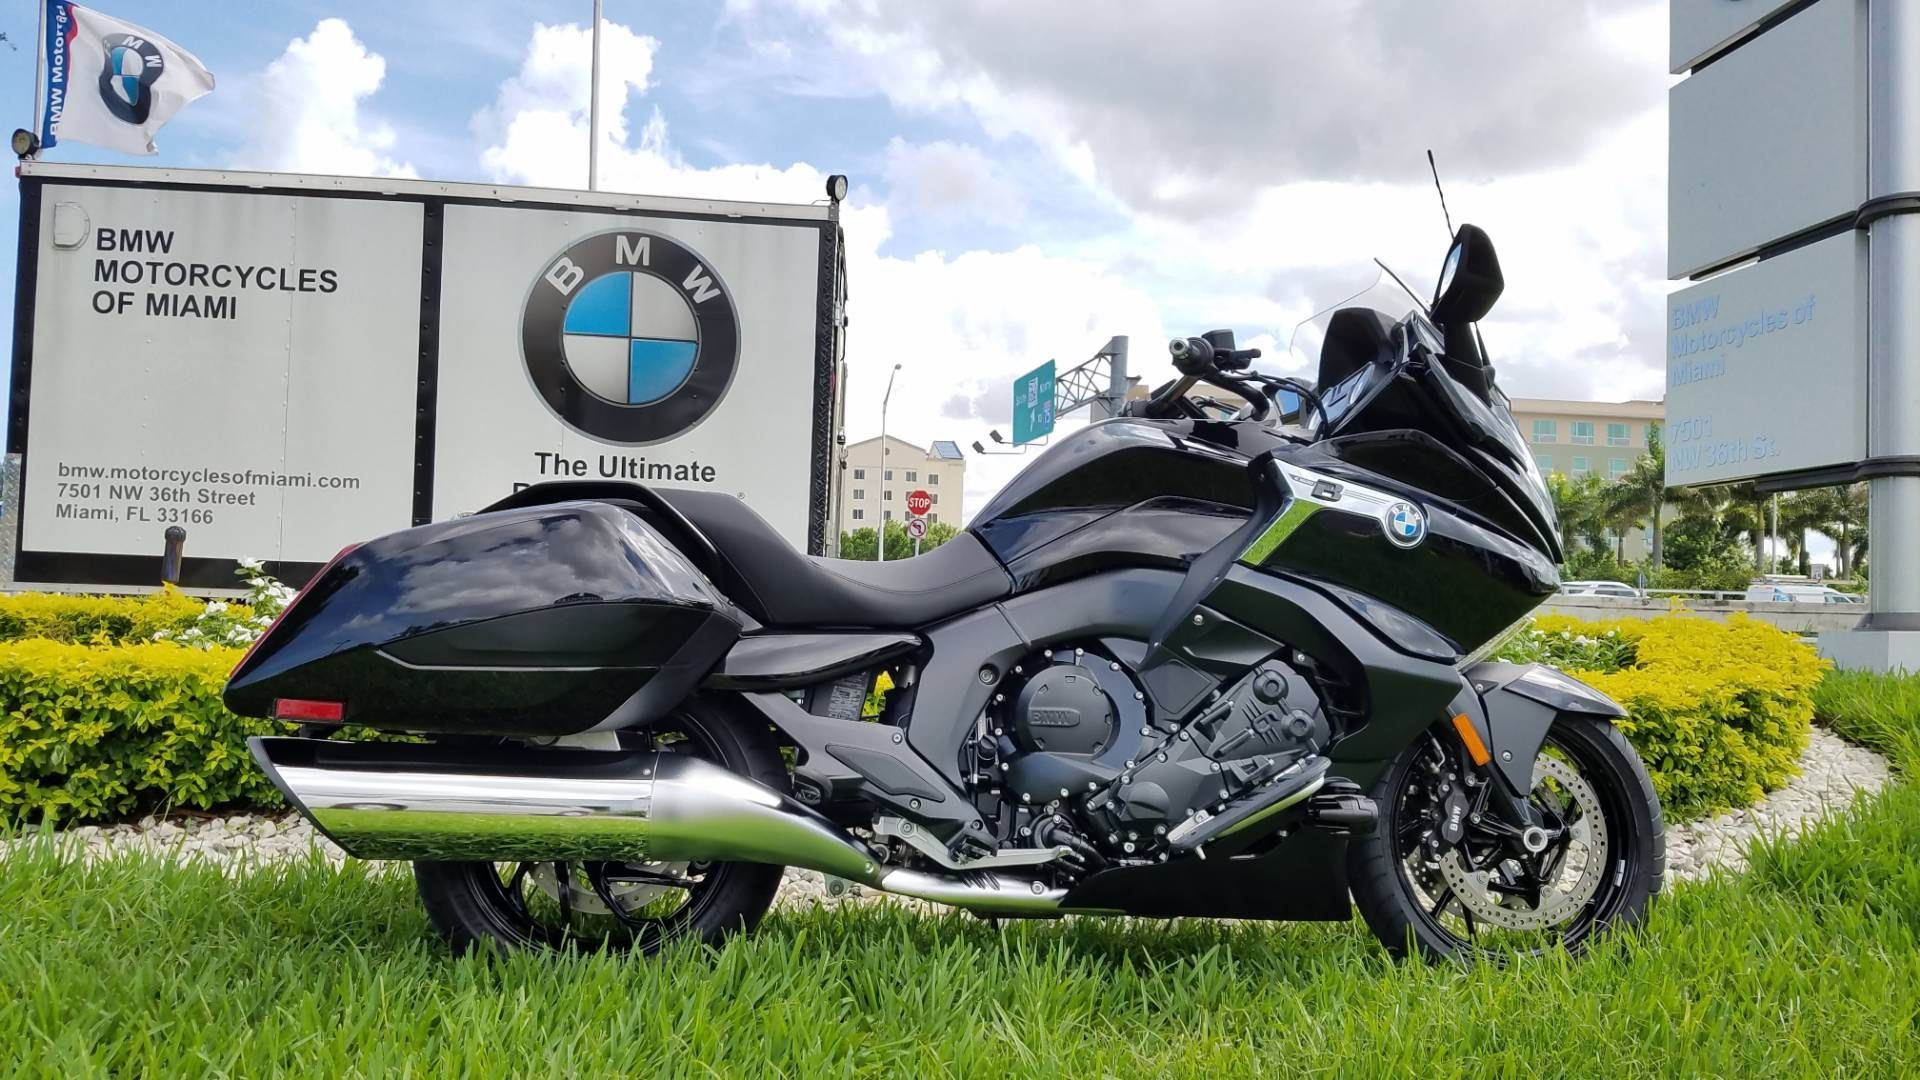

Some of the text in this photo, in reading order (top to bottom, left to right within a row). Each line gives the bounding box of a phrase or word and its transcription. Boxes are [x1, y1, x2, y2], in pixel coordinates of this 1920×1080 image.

[96, 228, 174, 254] BMW
[94, 259, 338, 293] MOTORCYCLES
[544, 235, 721, 304] BMW
[92, 290, 237, 319] OF MIAMI
[1672, 295, 1720, 330] BMW
[1671, 295, 1816, 358] Motorcycles of
[1671, 354, 1726, 388] Miami
[1671, 416, 1712, 444] 7501
[534, 452, 716, 482] The Ultimate
[1670, 446, 1701, 472] NW
[1704, 437, 1748, 467] 36th
[58, 462, 360, 489] bmw.motorcyclesofmiami.com
[57, 483, 256, 507] 7501 NW 36th Street
[908, 497, 931, 509] STOP
[55, 503, 214, 525] Miami, FL 33166
[1449, 805, 1461, 831] BMW
